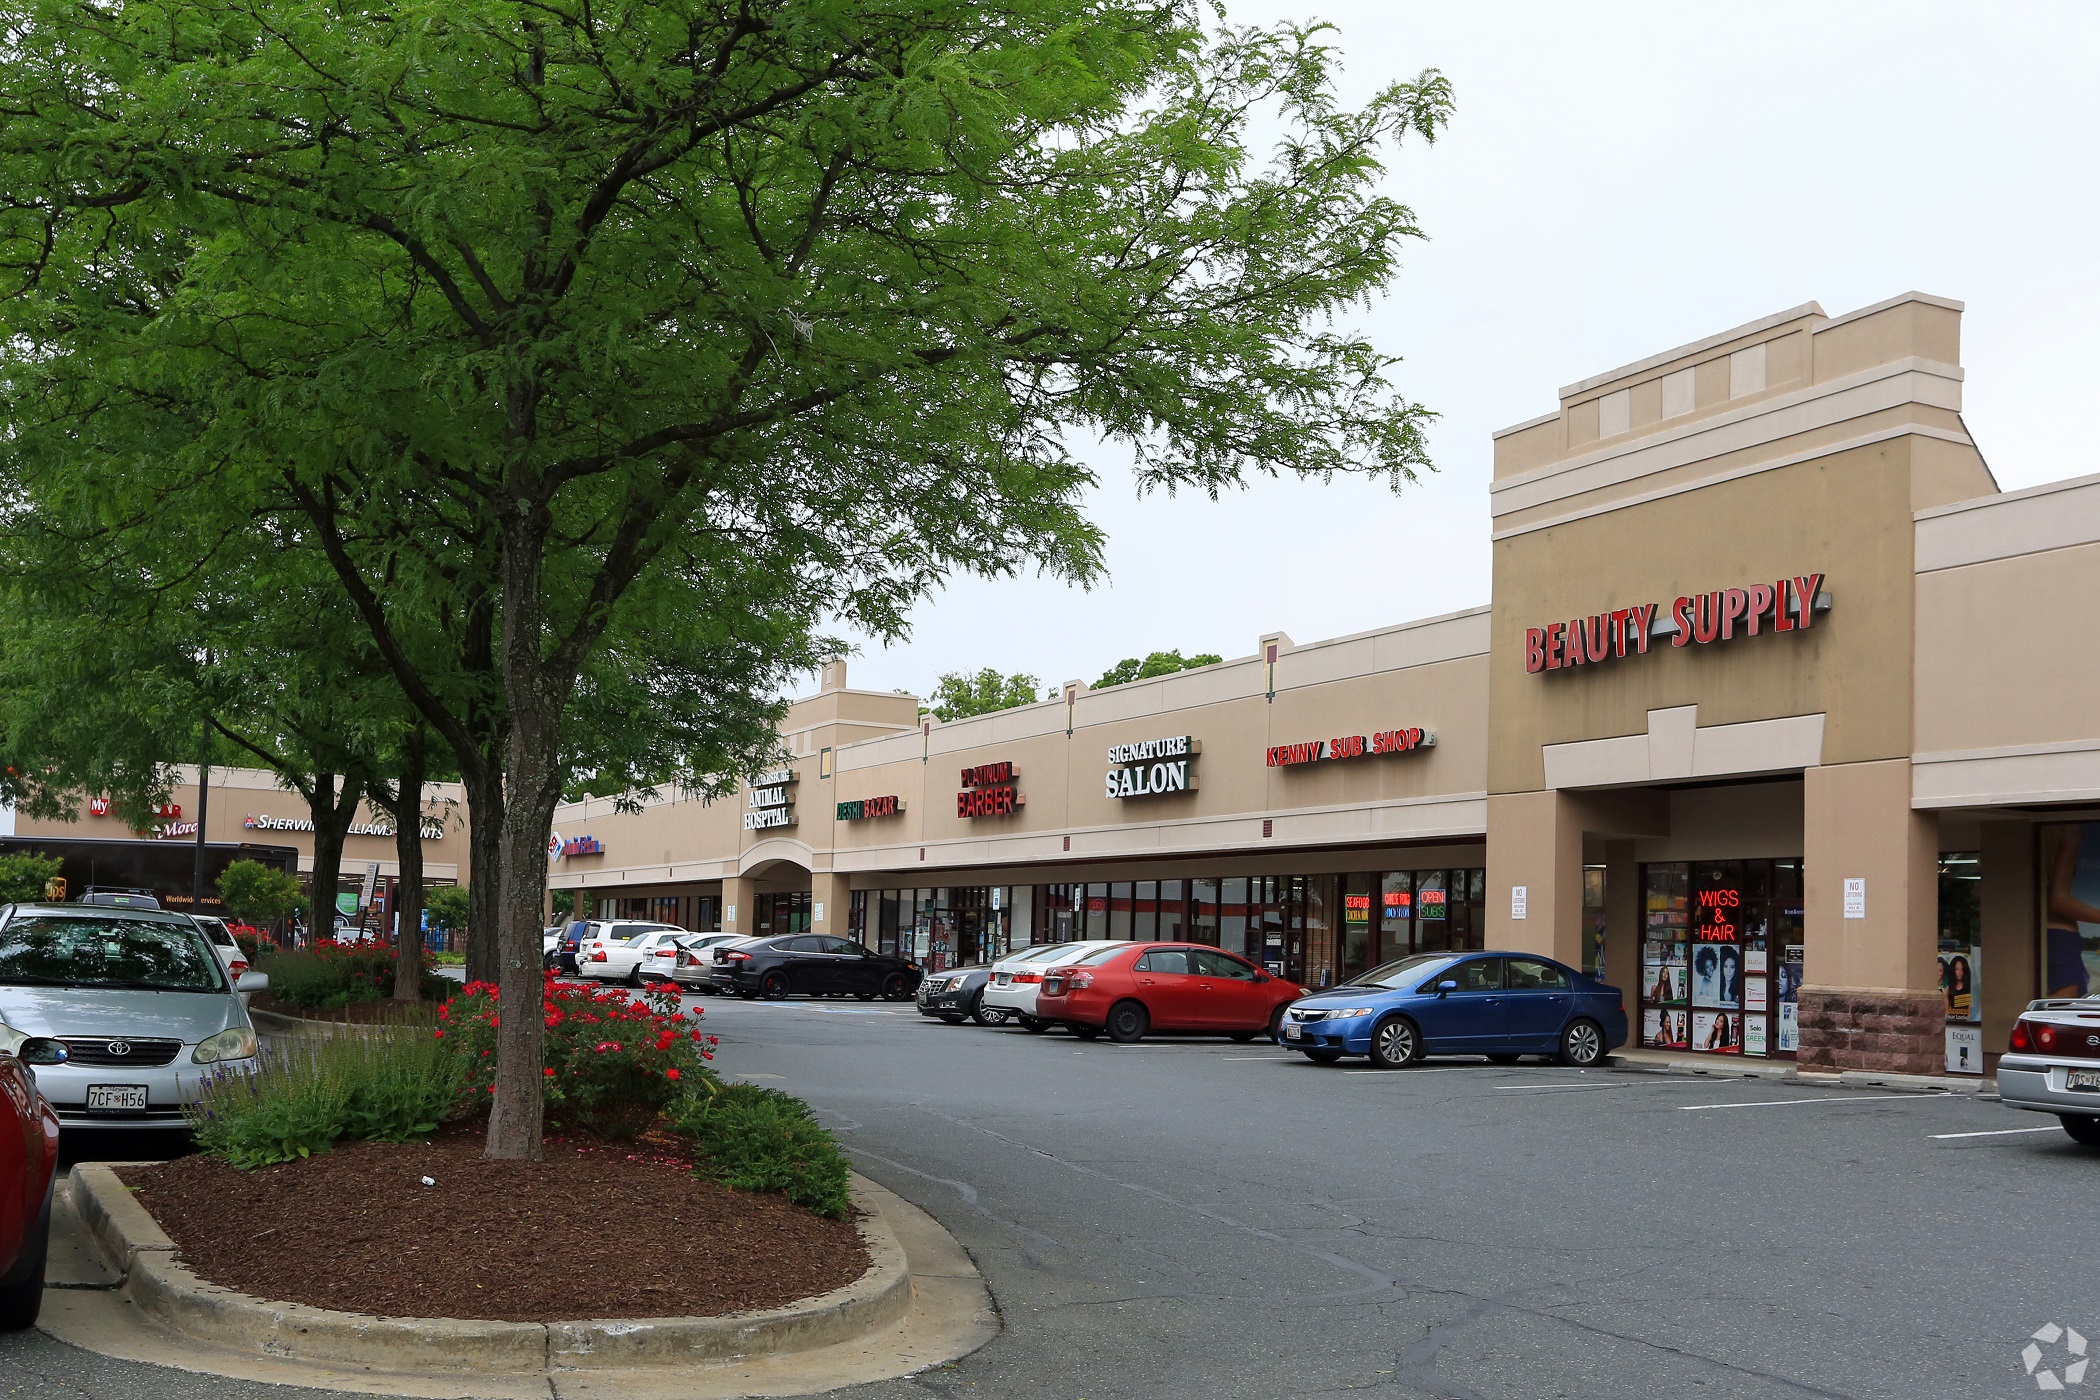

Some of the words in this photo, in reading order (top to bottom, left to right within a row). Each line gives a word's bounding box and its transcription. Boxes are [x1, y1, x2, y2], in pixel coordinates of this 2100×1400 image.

[1525, 603, 1657, 674] BEAUTY
[1672, 573, 1824, 648] SUPPLY
[1107, 735, 1187, 764] SIGNATURE
[1266, 740, 1321, 767] KENNY
[1329, 735, 1363, 760] SUB
[1372, 727, 1422, 755] SHOP
[961, 762, 1010, 788] PLATINUM
[1105, 760, 1187, 799] SALON
[749, 787, 786, 808] ANIMAL
[958, 786, 1014, 818] BARBER
[91, 799, 108, 815] My
[837, 801, 862, 820] DESHI
[864, 796, 896, 818] BAZAR
[258, 814, 316, 832] SHERWI
[744, 807, 788, 830] HOSPITAL
[158, 821, 198, 839] More
[1849, 882, 1859, 891] NO
[166, 895, 194, 904] Worldwid
[200, 897, 221, 905] ervices
[1421, 891, 1445, 904] OPEN
[1700, 889, 1739, 907] WIGS
[1714, 908, 1725, 923] &
[1701, 924, 1735, 941] HAIR
[1749, 1024, 1762, 1032] Solo
[1952, 1031, 1975, 1041] EQUAL
[1746, 1034, 1766, 1043] GREEN
[91, 1092, 113, 1106] 7CF
[121, 1092, 144, 1107] H56
